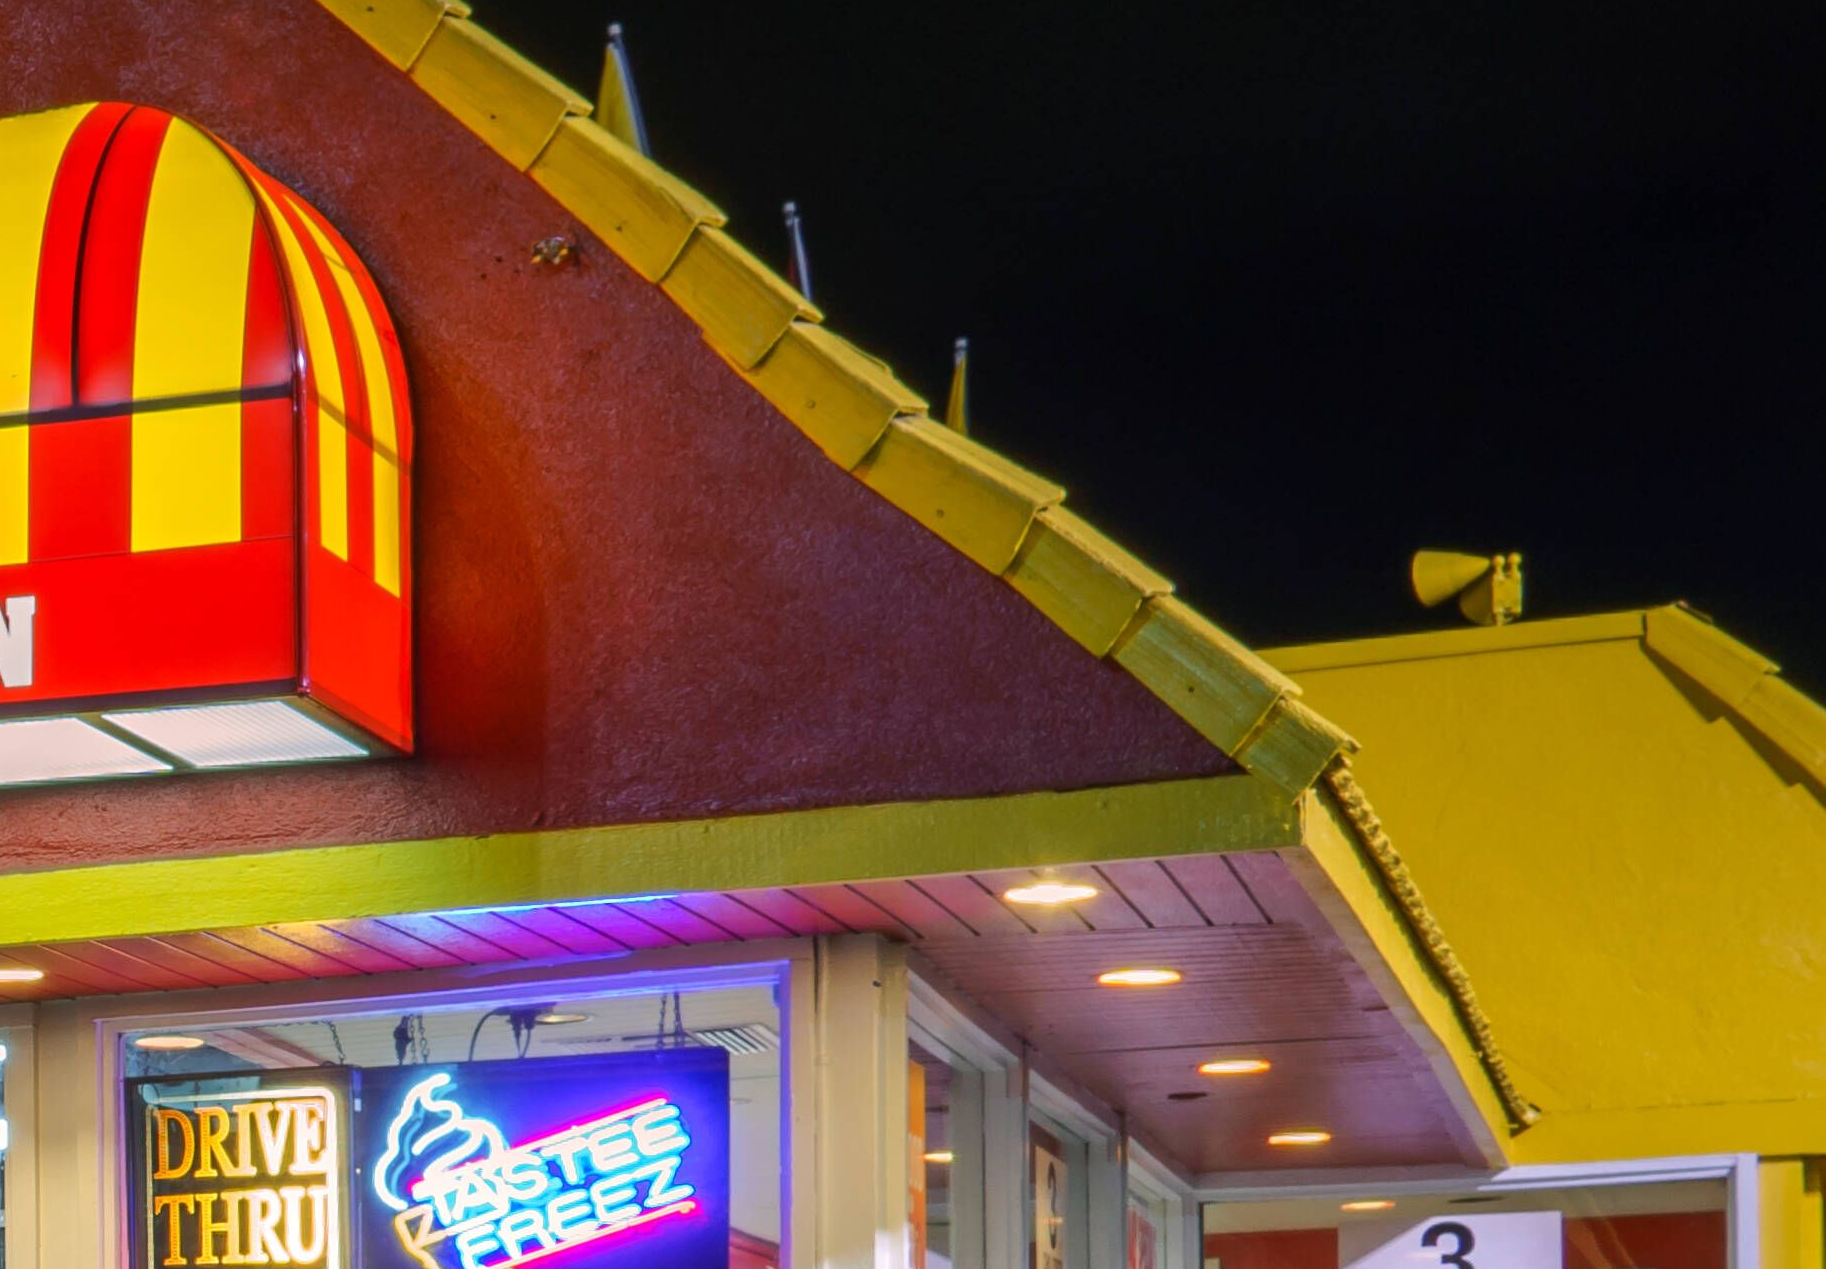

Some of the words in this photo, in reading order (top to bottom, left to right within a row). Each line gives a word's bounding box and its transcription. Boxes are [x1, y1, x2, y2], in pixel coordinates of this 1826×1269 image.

[153, 1098, 329, 1180] DRIVE
[413, 1105, 690, 1225] TASTEE
[154, 1186, 329, 1266] THRU
